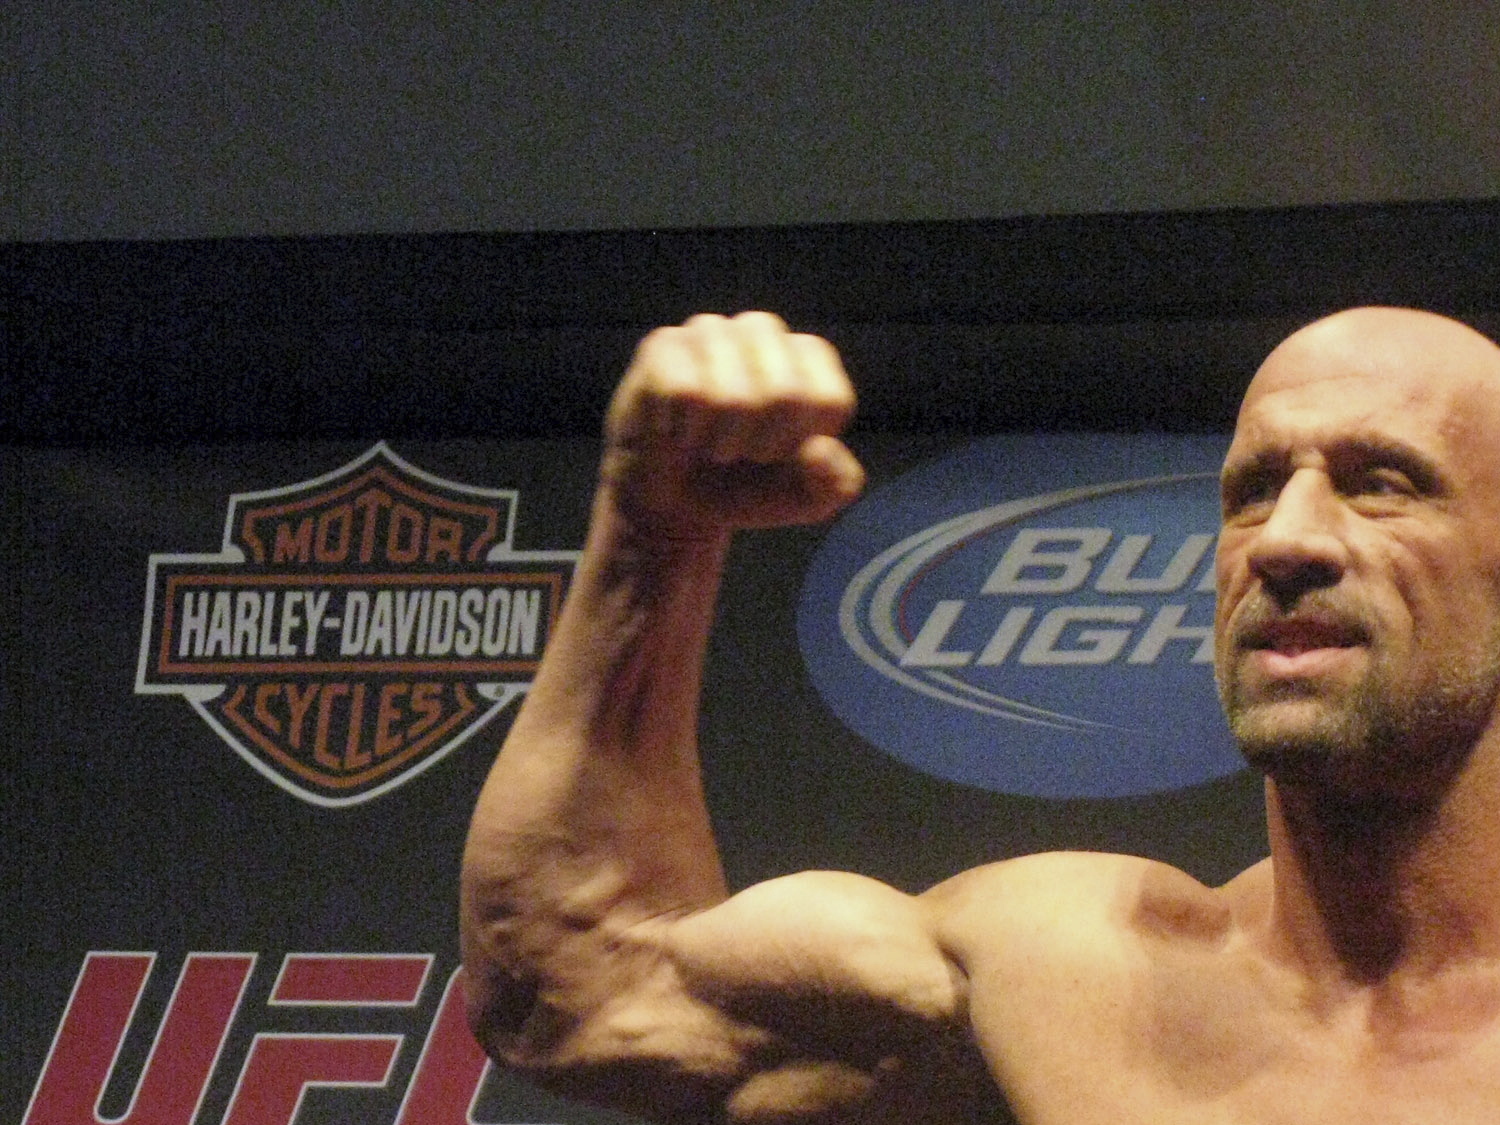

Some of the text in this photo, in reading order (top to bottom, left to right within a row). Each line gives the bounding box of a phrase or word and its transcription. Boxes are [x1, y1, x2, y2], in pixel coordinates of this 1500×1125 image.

[274, 490, 463, 563] MOTOR
[980, 527, 1218, 593] BU
[178, 589, 542, 656] HARLEY-DAVIDSON
[901, 600, 1214, 666] LIGH
[254, 683, 444, 770] CYCLES
